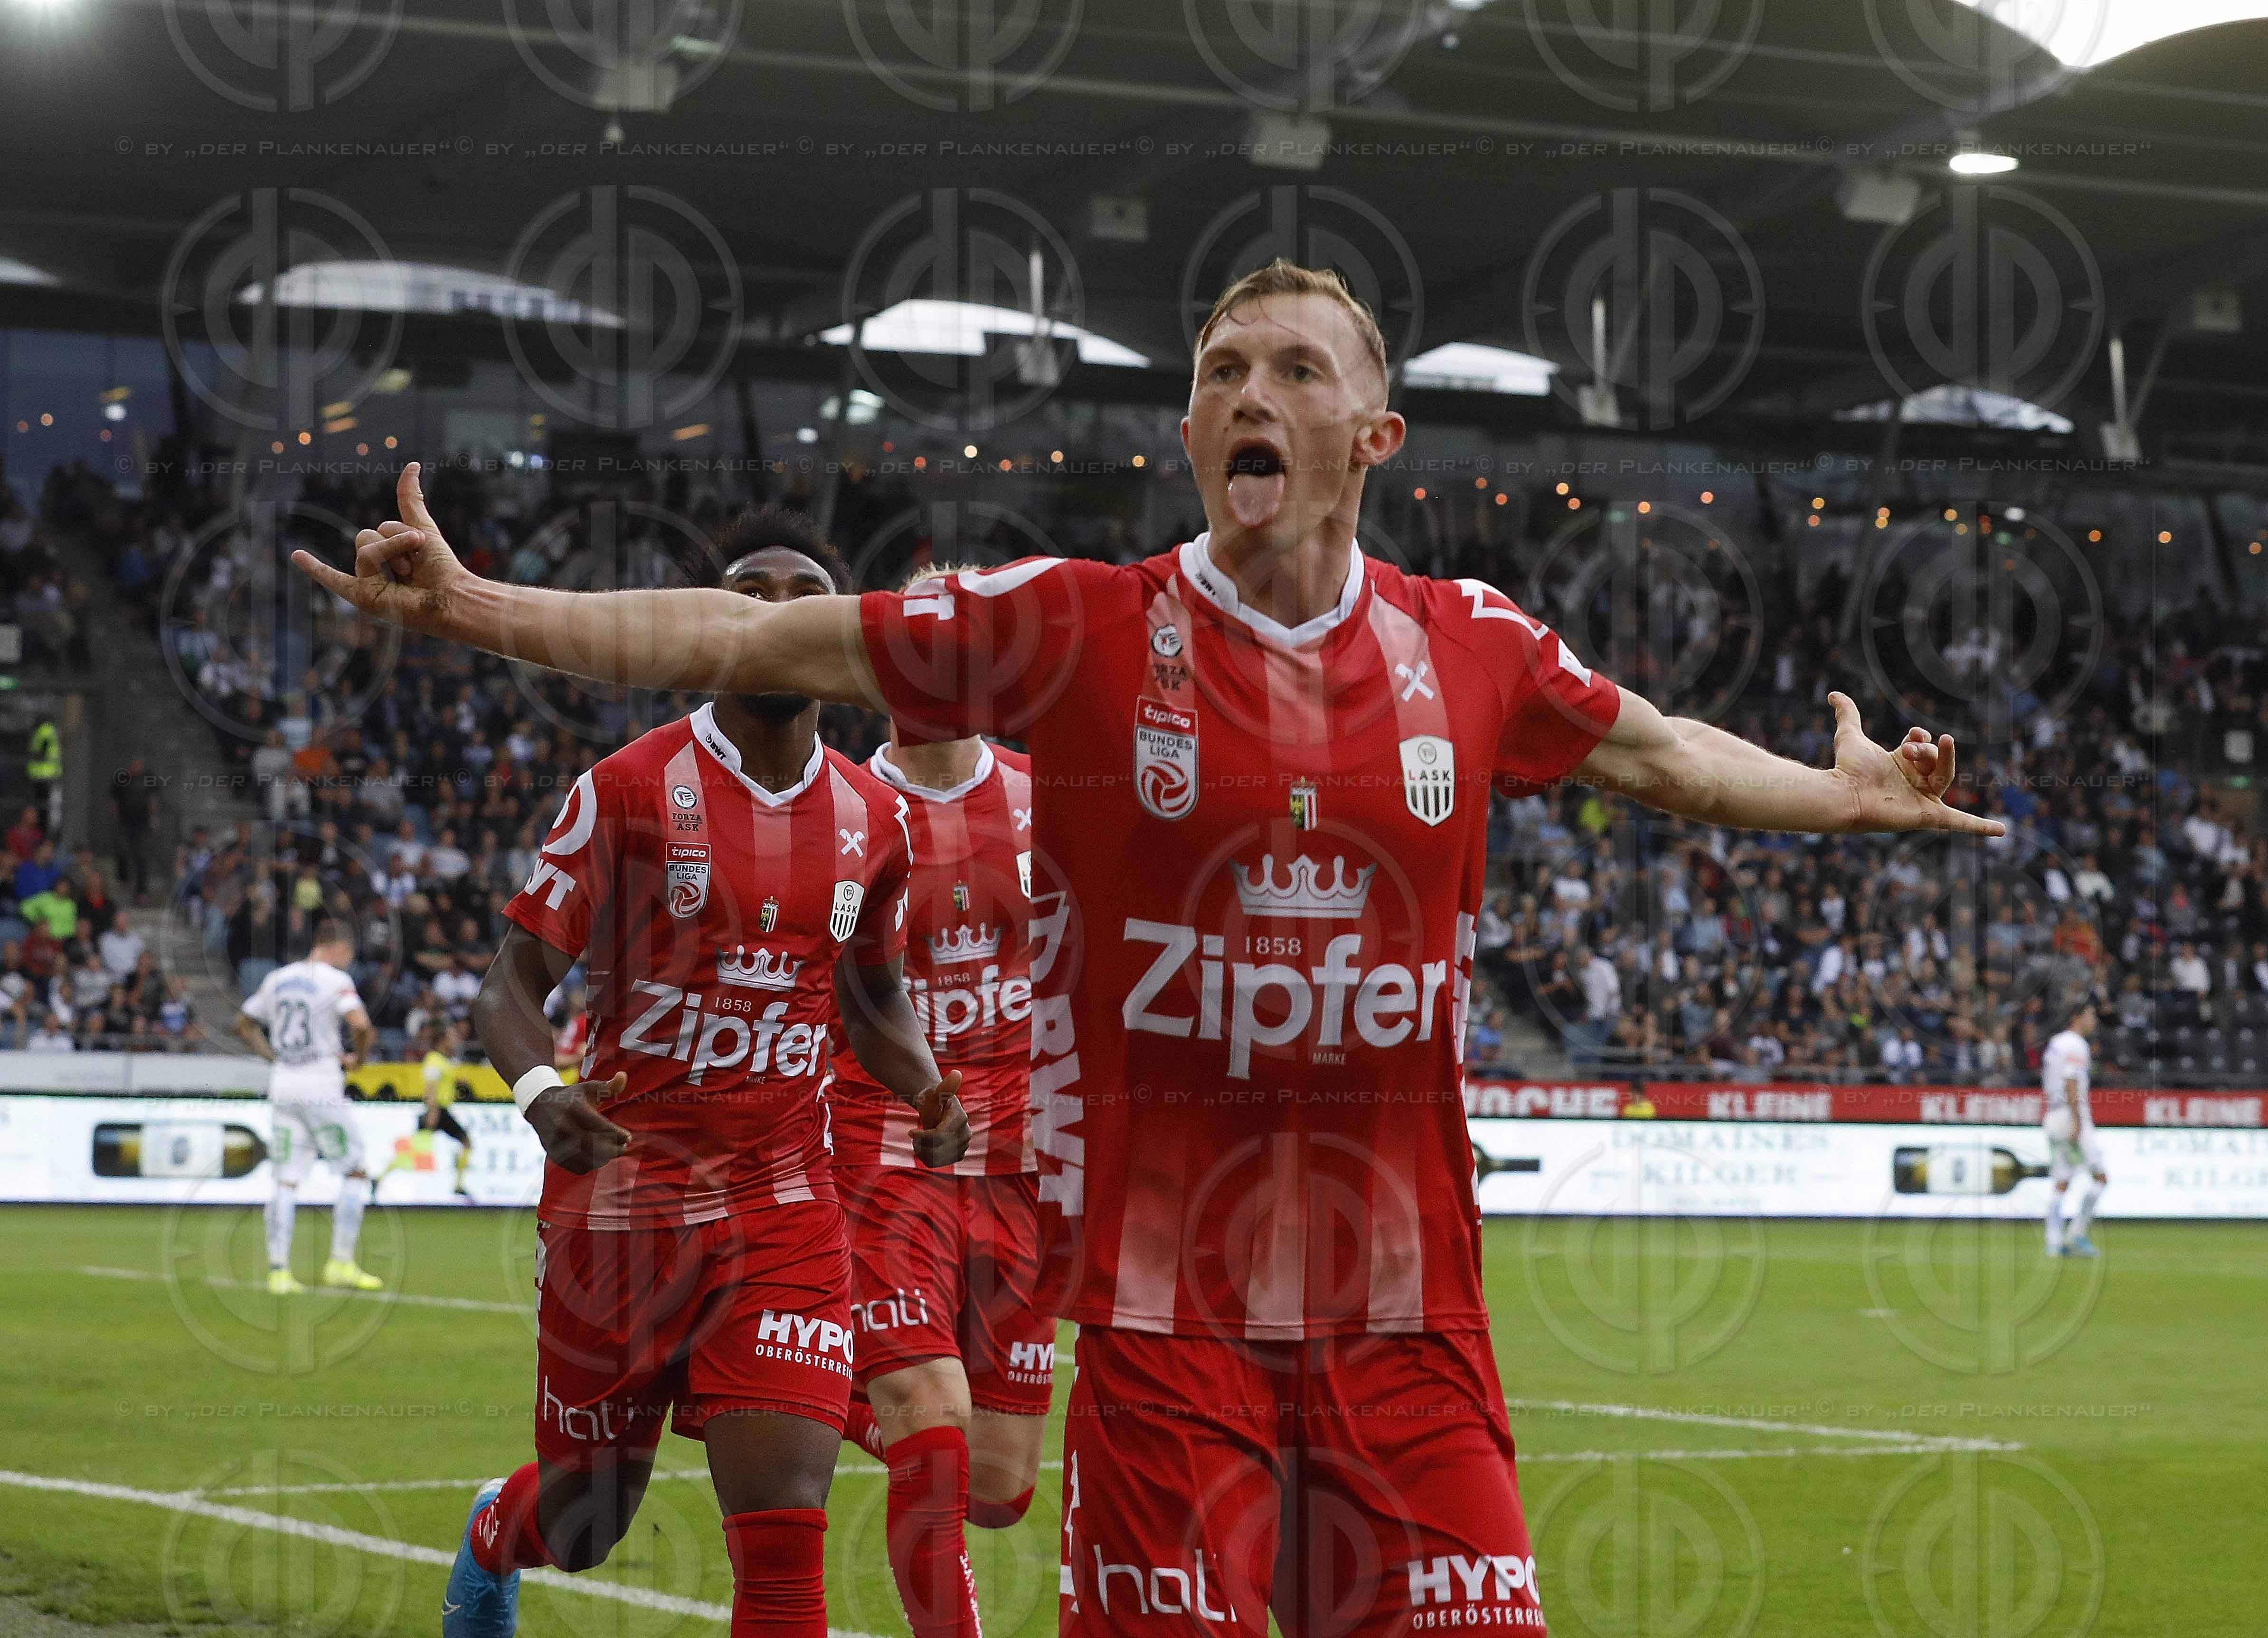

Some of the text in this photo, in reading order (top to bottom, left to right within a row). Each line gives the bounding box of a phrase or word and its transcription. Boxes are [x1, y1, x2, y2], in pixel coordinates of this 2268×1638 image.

[1144, 705, 1191, 728] tipico
[1140, 730, 1192, 750] BUNDES
[710, 741, 727, 760] BWT
[1150, 744, 1180, 758] LIGA
[1408, 769, 1450, 781] LASK
[676, 823, 699, 831] ASK
[671, 847, 707, 858] tipico
[669, 865, 707, 874] BUNDES
[835, 902, 858, 914] LASK
[1245, 937, 1302, 956] 1858
[715, 997, 752, 1012] 1858
[900, 964, 1032, 1052] ipfe
[1123, 917, 1446, 1080] Zipfer
[619, 979, 827, 1086] Zipfer
[757, 1309, 853, 1365] HYPO
[1408, 1554, 1541, 1607] HYPO
